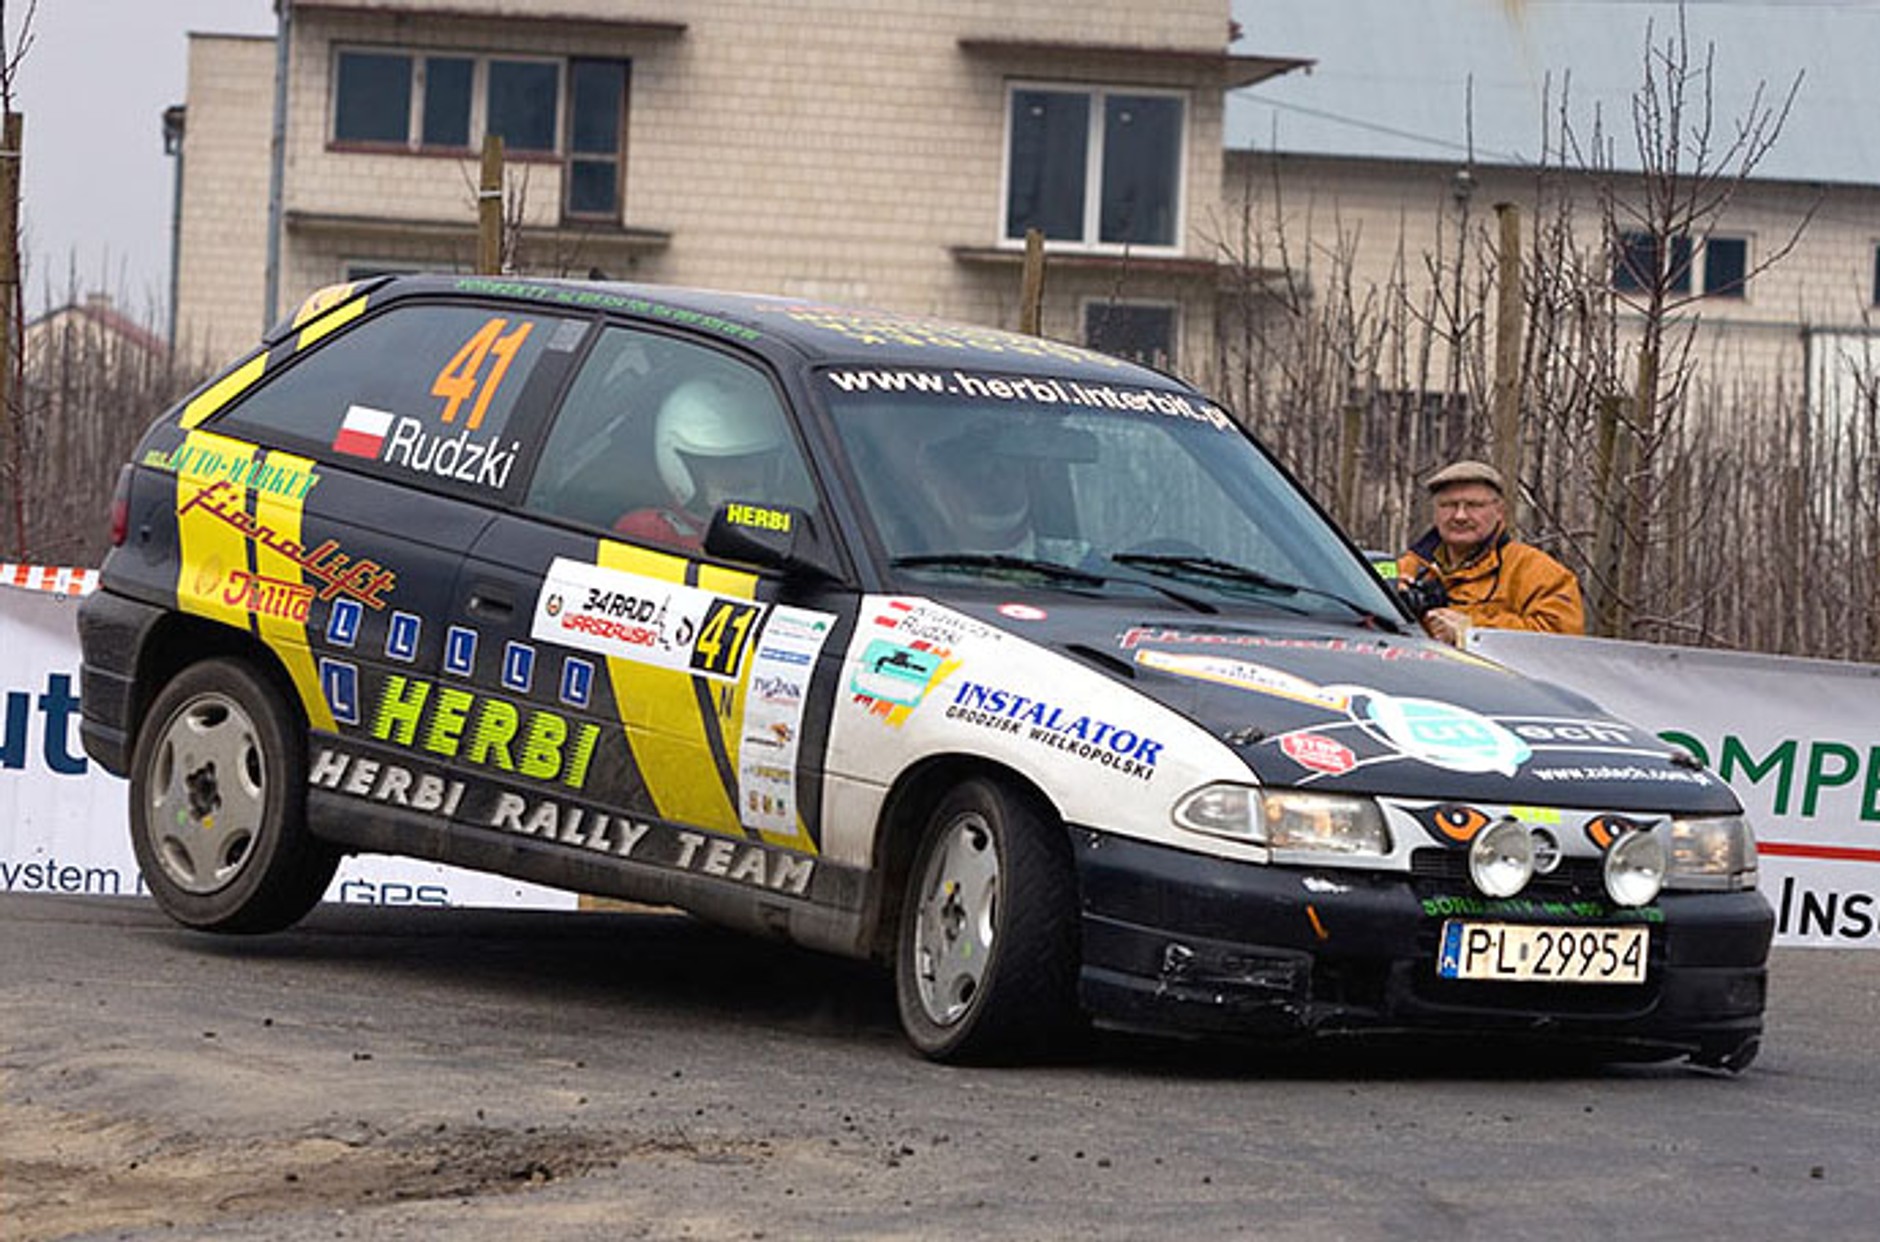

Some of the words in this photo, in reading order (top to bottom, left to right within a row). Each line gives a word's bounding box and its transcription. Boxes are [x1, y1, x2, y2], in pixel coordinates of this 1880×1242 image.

[430, 317, 535, 430] 41
[384, 417, 521, 490] Rudzki
[727, 503, 791, 532] HERBI
[583, 587, 612, 613] 34
[697, 603, 758, 675] 41
[371, 674, 600, 789] HERBI
[945, 704, 1020, 736] GRODZISK
[1028, 729, 1155, 781] WIELKOPOLSKI
[953, 681, 1166, 767] INSTALATOR
[307, 750, 466, 817] HERBI
[491, 792, 651, 858] RALLY
[675, 830, 819, 895] TEAM
[1466, 928, 1517, 974] PL
[1533, 931, 1643, 978] 29954
